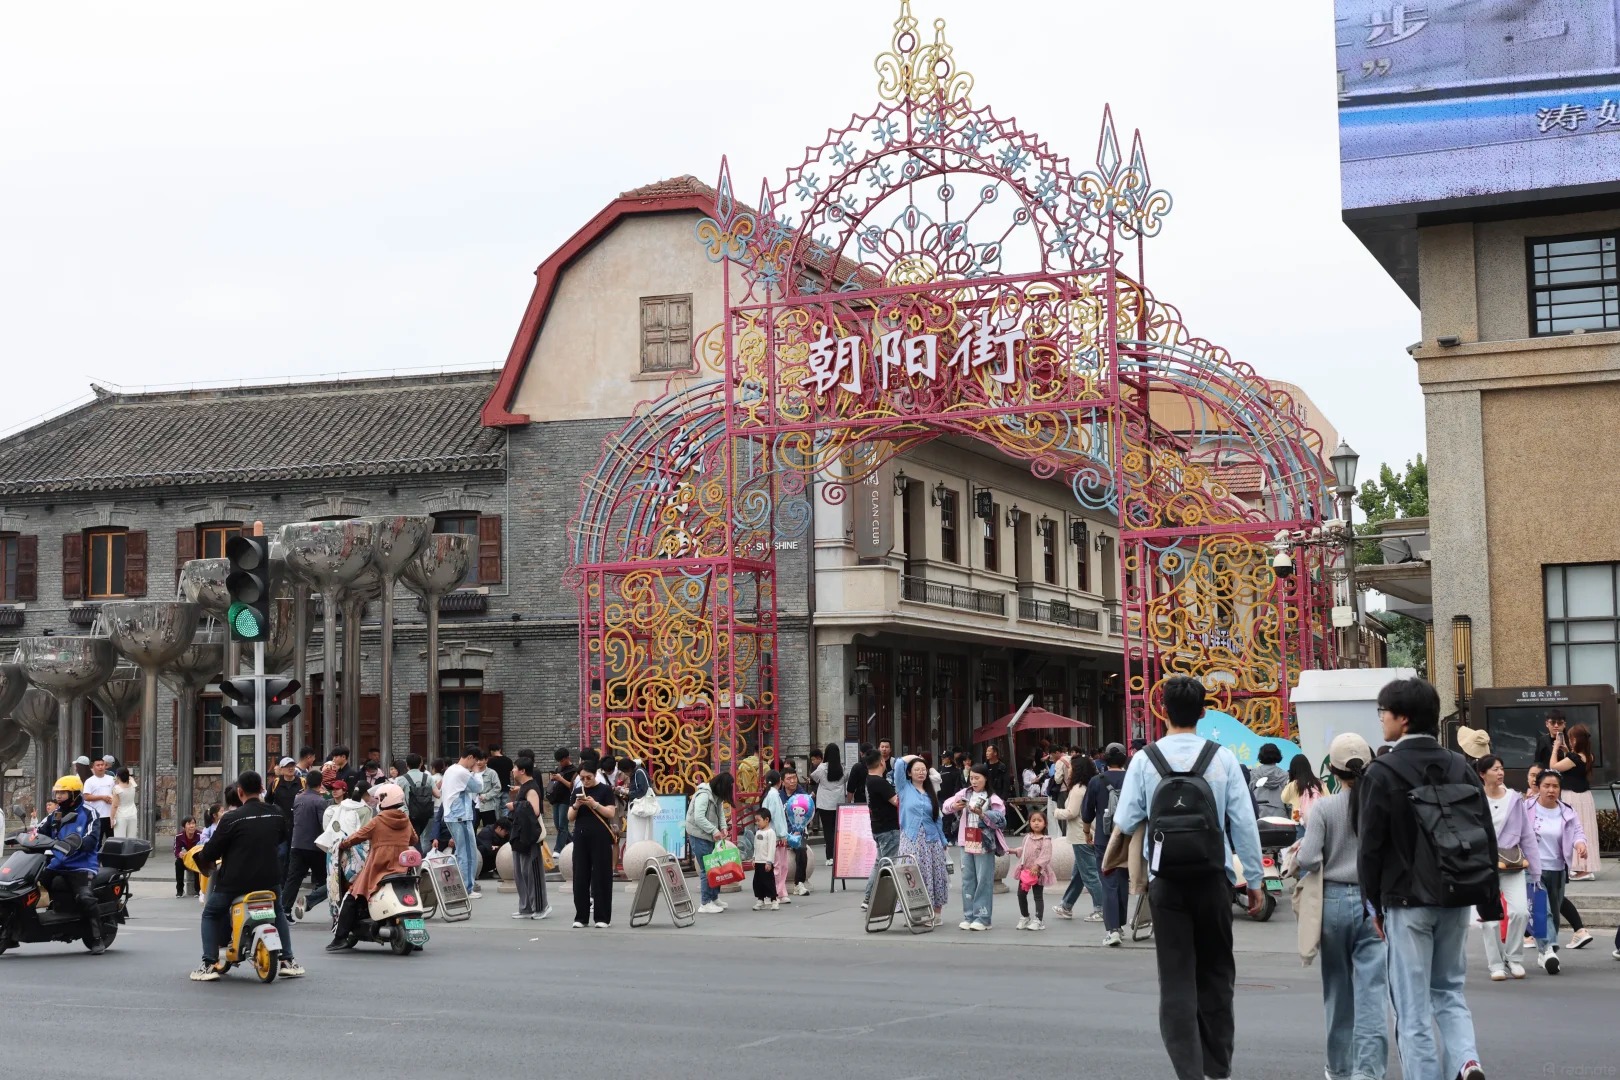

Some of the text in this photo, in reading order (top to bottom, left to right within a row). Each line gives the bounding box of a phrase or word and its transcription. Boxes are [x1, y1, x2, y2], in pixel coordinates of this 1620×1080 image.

[800, 309, 1026, 396] 朝阳街
[871, 490, 880, 545] GLAN CLUB
